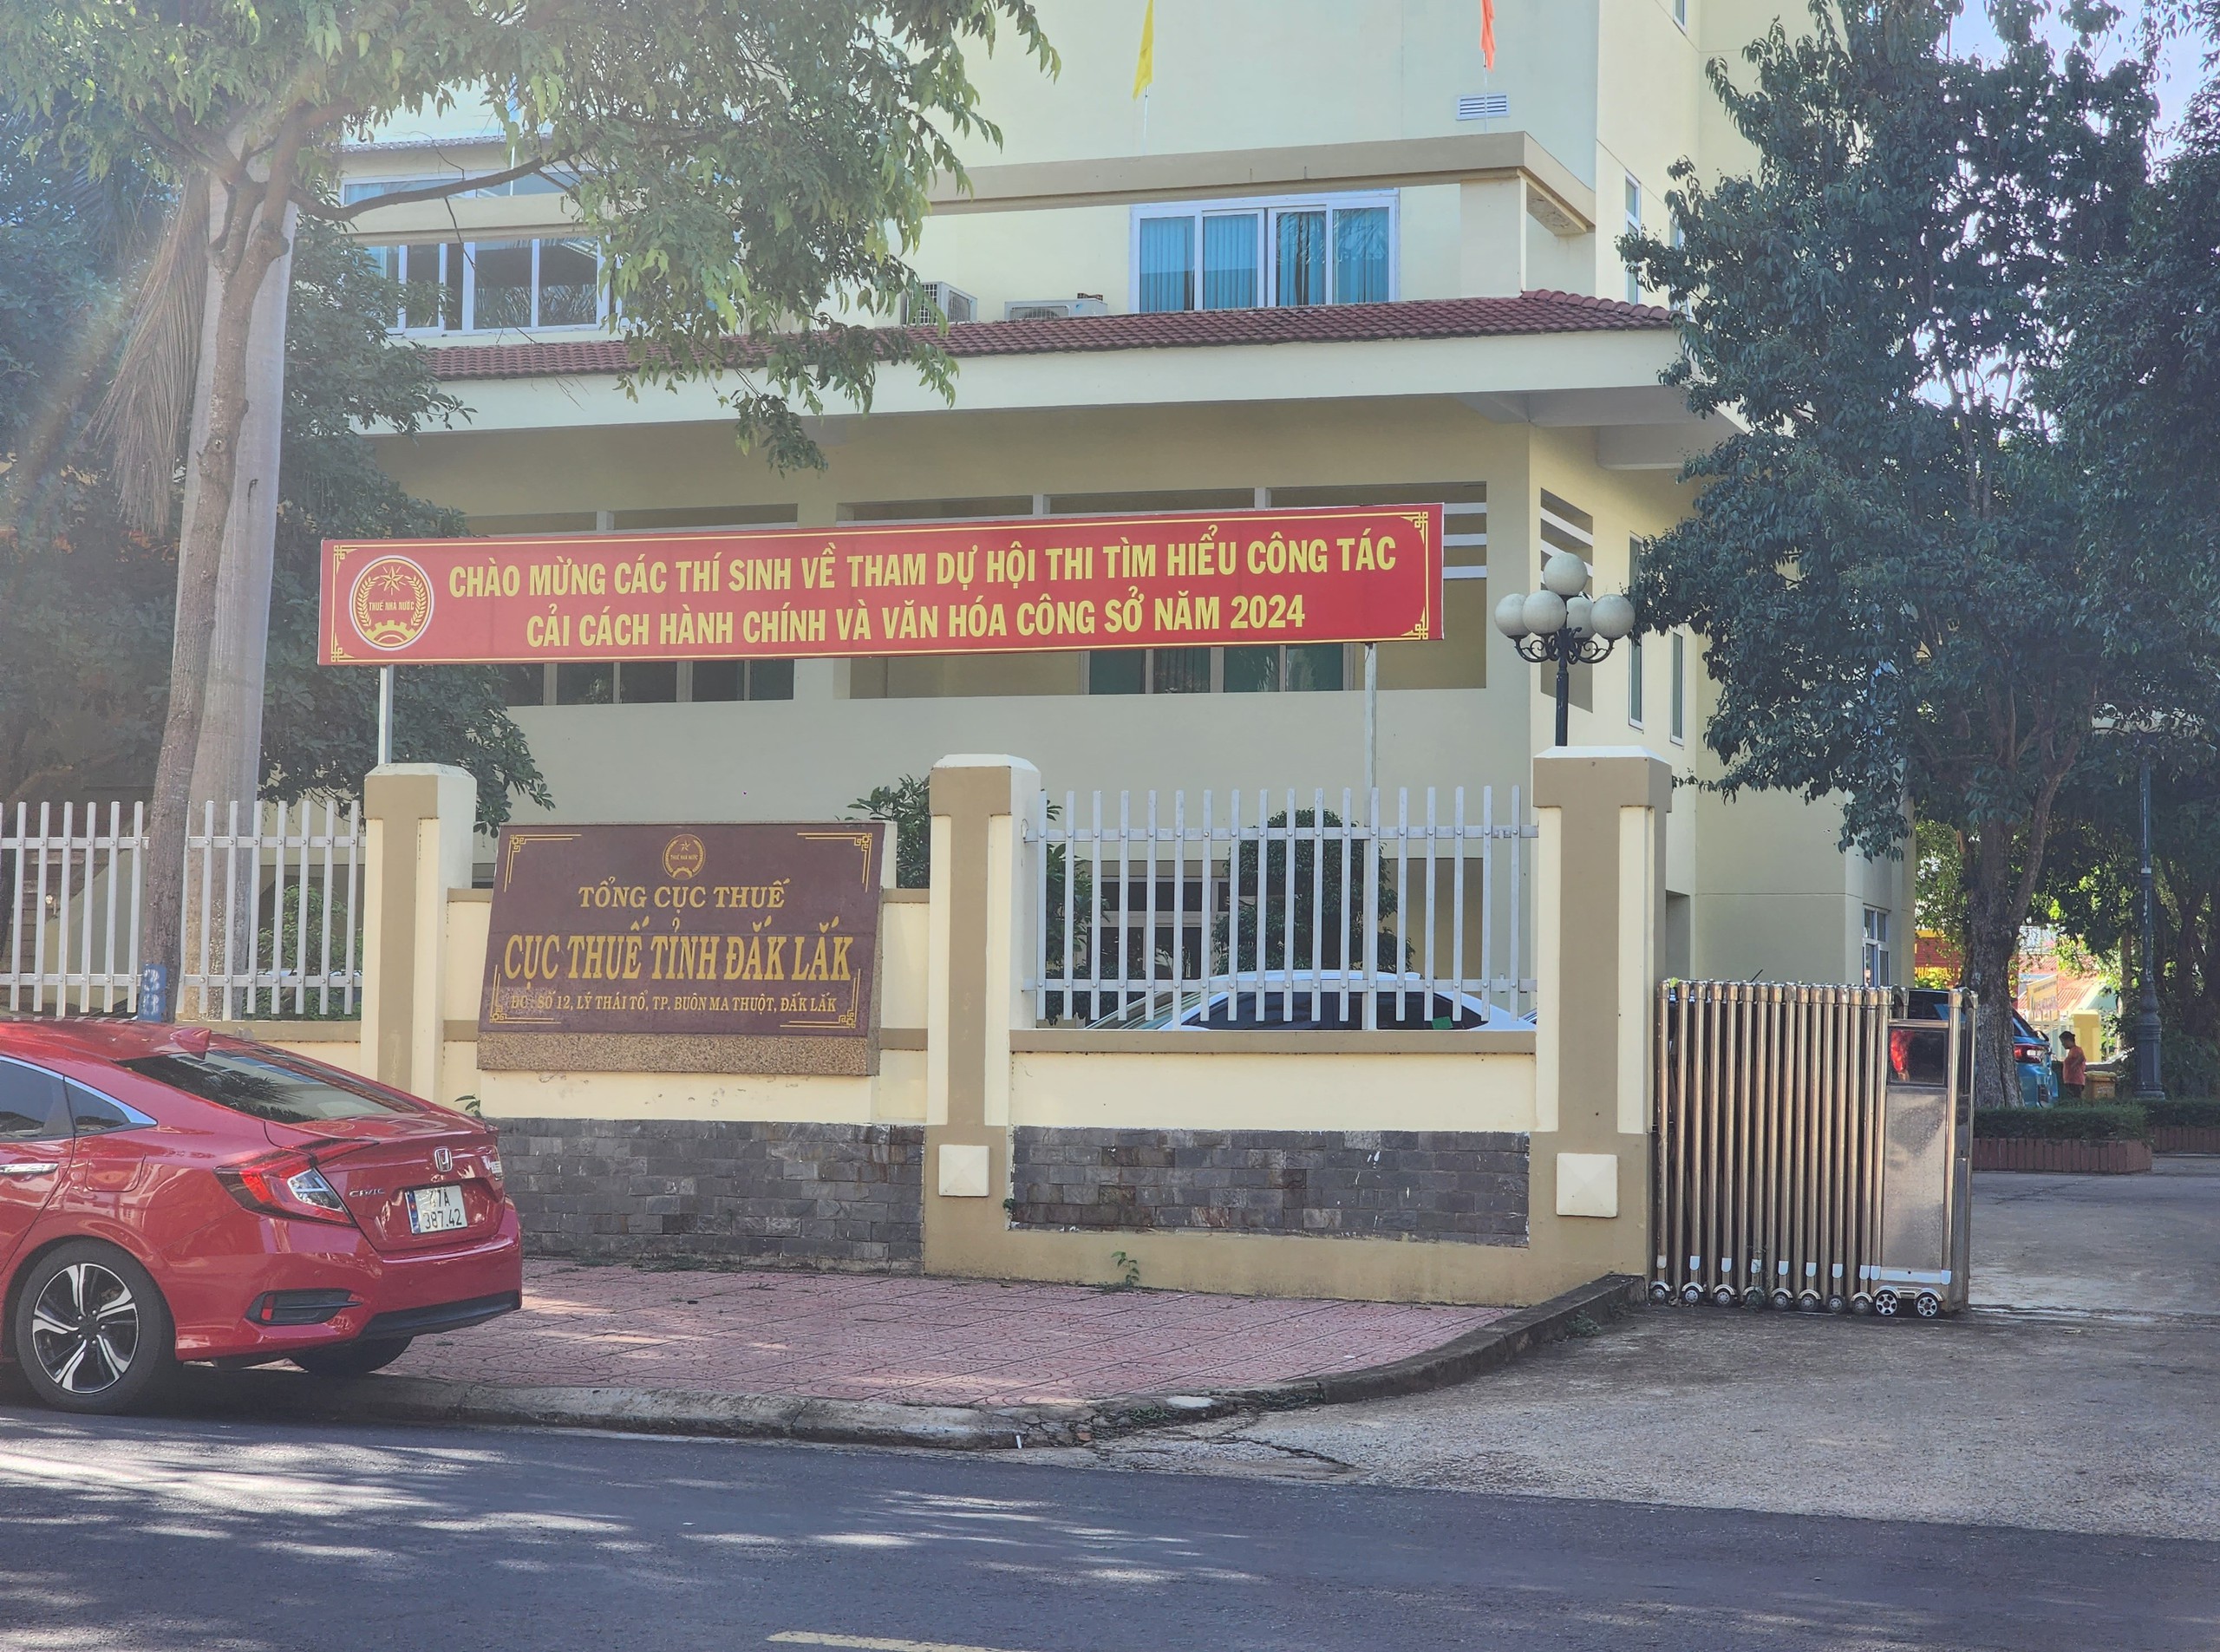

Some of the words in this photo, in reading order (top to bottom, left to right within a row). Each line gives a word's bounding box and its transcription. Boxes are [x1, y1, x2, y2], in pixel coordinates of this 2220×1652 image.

[449, 557, 520, 597] CHÀO
[529, 557, 606, 597] MỪNG
[615, 554, 667, 595] CÁC
[676, 552, 722, 592] THÍ
[729, 558, 792, 591] SINH
[801, 542, 836, 589] VỀ
[846, 553, 926, 587] THAM
[937, 545, 978, 591] DỰ
[987, 540, 1035, 589] HỘI
[1045, 546, 1094, 581] THI
[1102, 537, 1156, 578] TÌM
[1167, 525, 1237, 577] HIỂU
[1247, 532, 1328, 575] CÔNG
[1336, 528, 1396, 571] TÁC
[526, 604, 570, 648] CẢI
[579, 606, 650, 647] CÁCH
[660, 604, 734, 644] HÀNH
[743, 602, 826, 643] CHÍNH
[836, 598, 872, 641] VÀ
[882, 600, 938, 639] VĂN
[949, 595, 1008, 637] HÓA
[1017, 594, 1095, 637] CÔNG
[1104, 586, 1145, 633] SỞ
[1154, 591, 1220, 631] NĂM
[1230, 594, 1305, 629] 2024
[578, 877, 648, 909] TỔNG
[654, 886, 706, 914] CỤC
[713, 878, 790, 909] THUẾ
[504, 934, 560, 989] CỤC
[566, 916, 650, 980] THUẾ
[650, 917, 717, 981] TỈNH
[723, 916, 788, 981] ĐẮK
[791, 916, 854, 981] LẮK
[537, 989, 556, 1009] SỐ
[556, 996, 573, 1011] 12,
[576, 992, 591, 1009] LÝ
[595, 992, 627, 1010] THÁI
[629, 989, 649, 1011] TỔ,
[652, 996, 670, 1010] TP.
[673, 993, 706, 1011] BUÔN
[708, 996, 729, 1012] MA
[731, 993, 777, 1015] THUỘT,
[780, 991, 808, 1012] ĐẮK
[810, 991, 838, 1012] LẮK
[422, 1208, 463, 1230] 387.42
